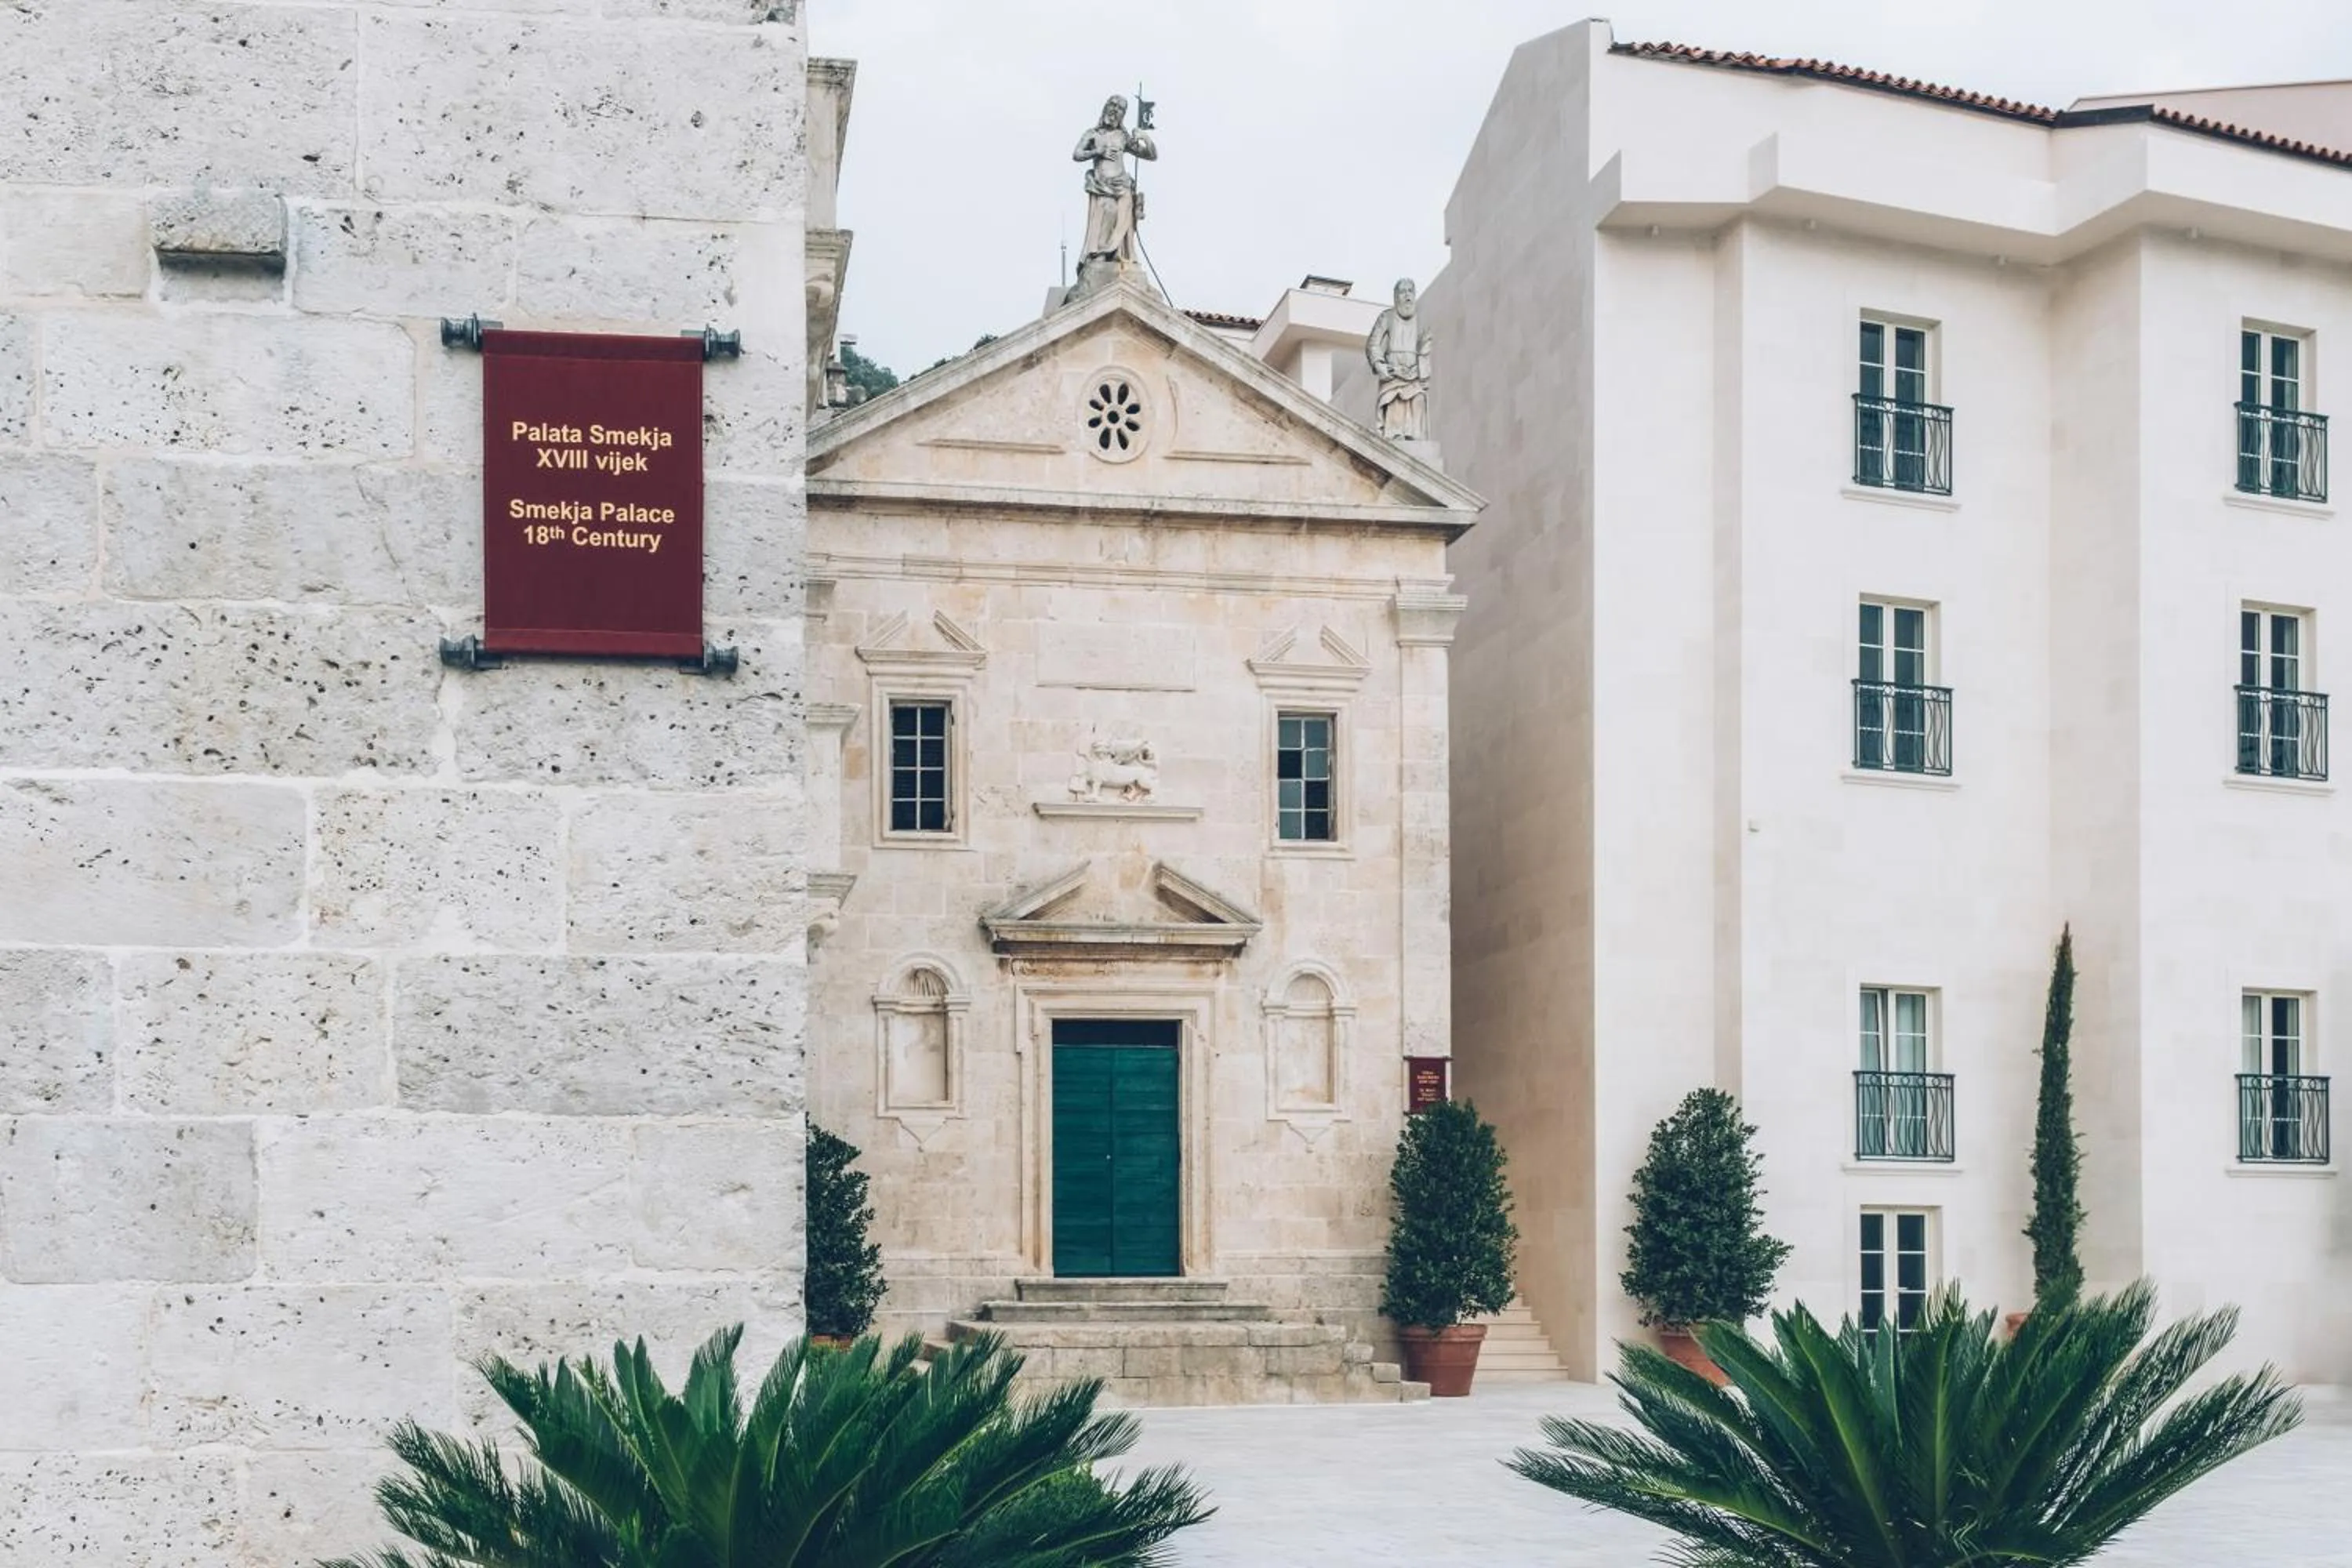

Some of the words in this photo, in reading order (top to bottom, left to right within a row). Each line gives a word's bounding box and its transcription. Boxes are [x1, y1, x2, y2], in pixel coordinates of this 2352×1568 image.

[513, 422, 582, 442] Palata
[590, 425, 672, 451] Smekja
[537, 448, 587, 468] XVIII
[595, 452, 648, 475] vijek
[510, 499, 592, 524] Smekja
[601, 503, 674, 523] Palace
[524, 525, 564, 544] 18th
[572, 527, 662, 553] Century
